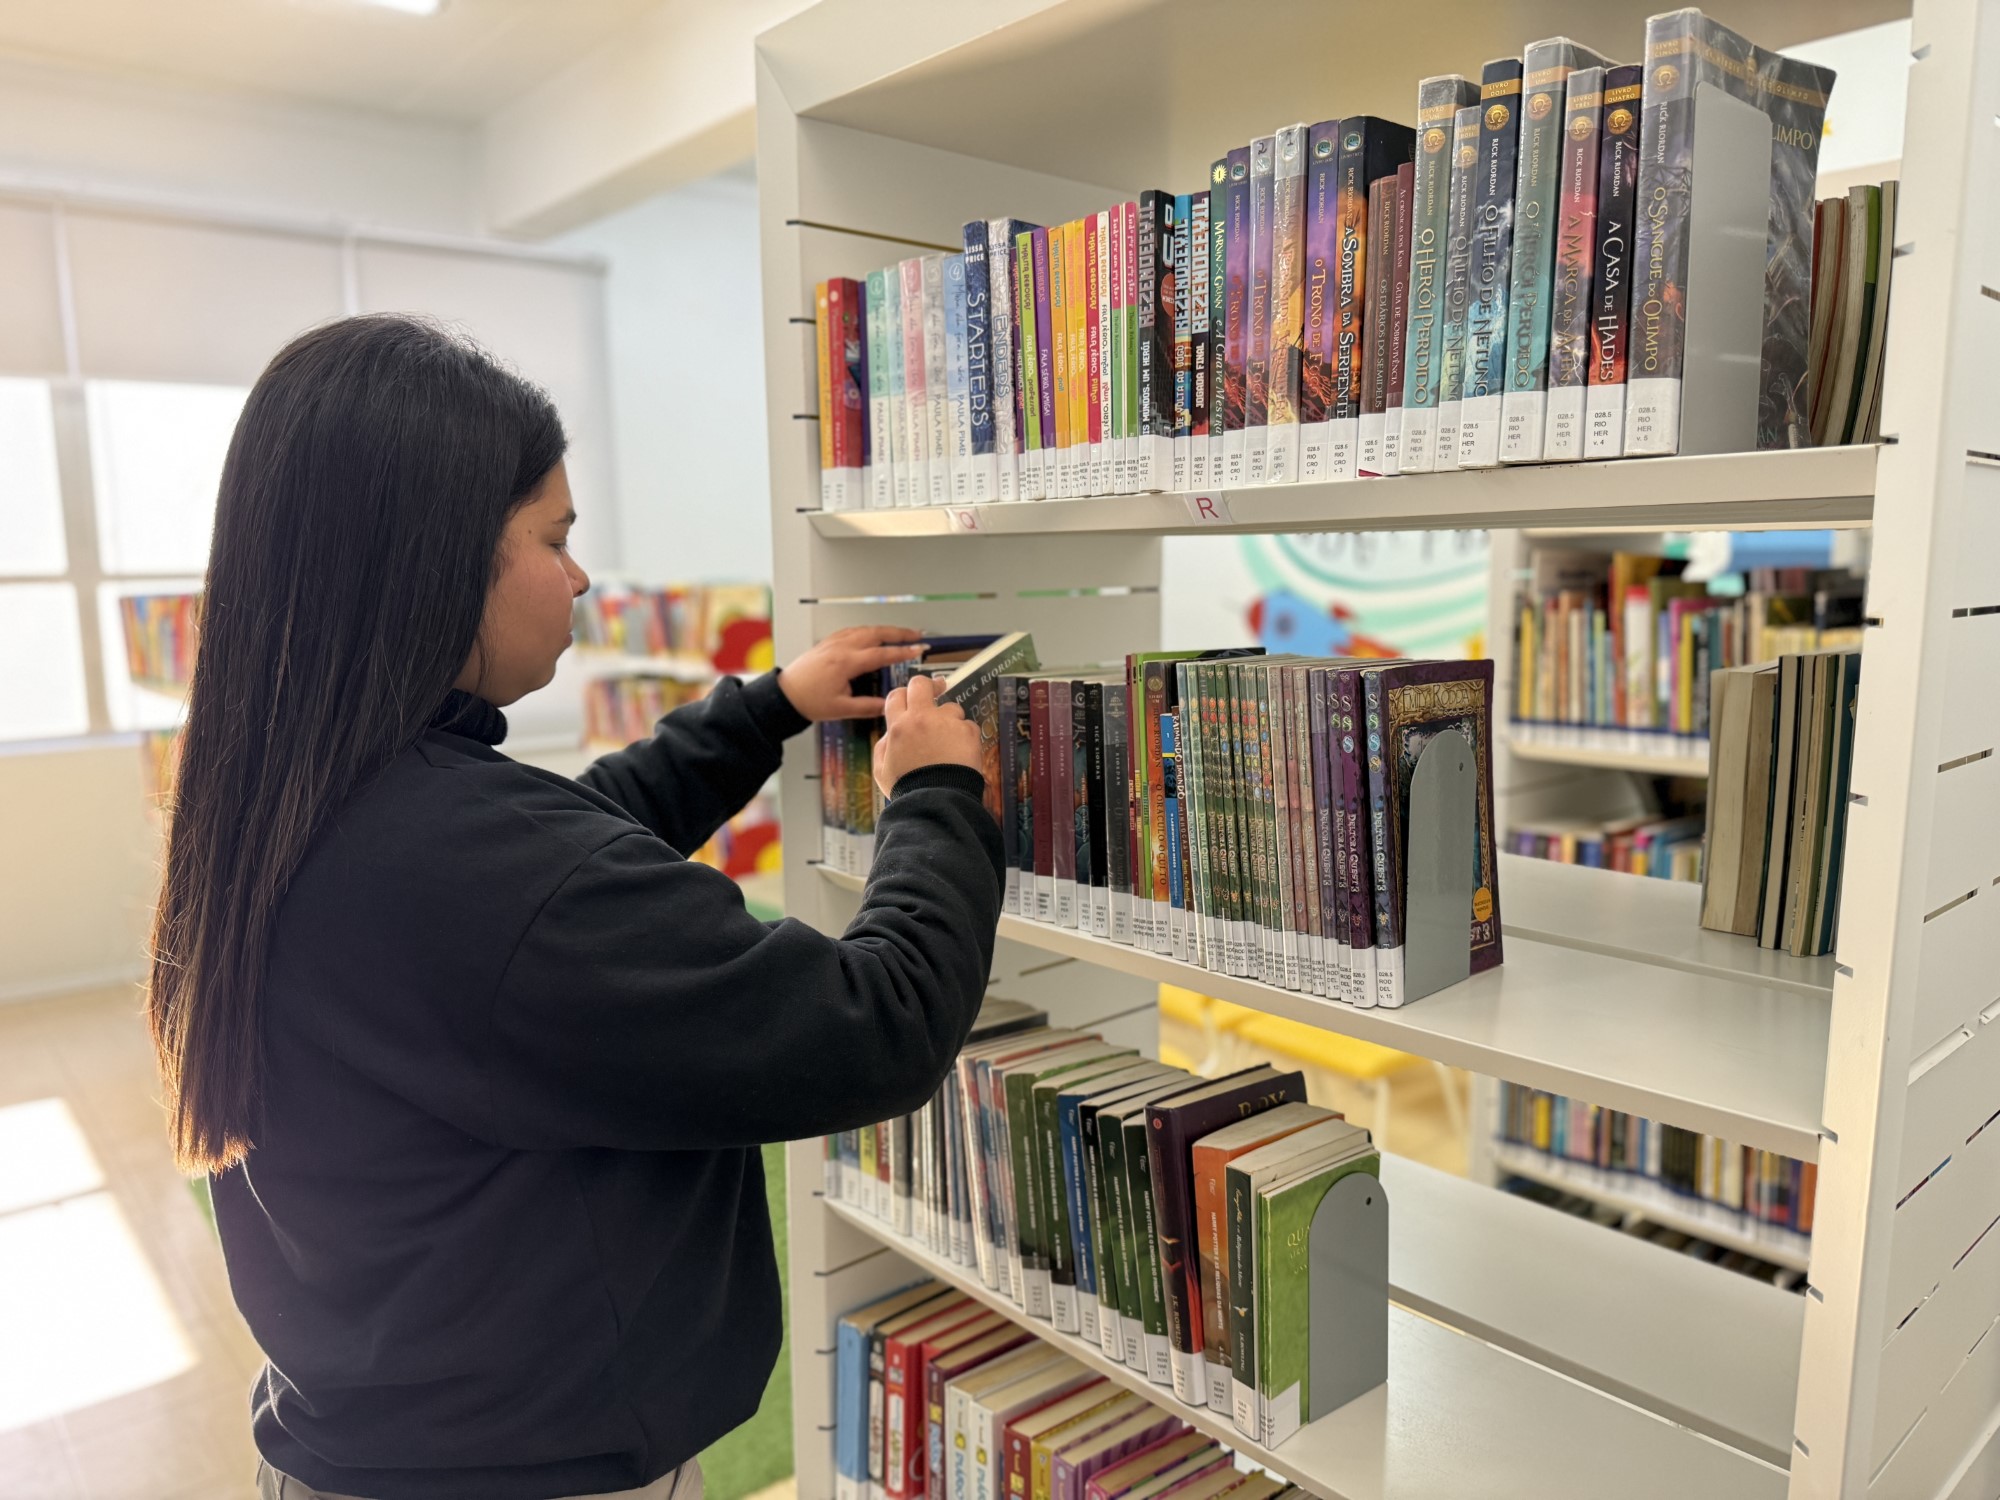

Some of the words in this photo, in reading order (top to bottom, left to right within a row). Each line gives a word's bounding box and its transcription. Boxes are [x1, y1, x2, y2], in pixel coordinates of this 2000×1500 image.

[1489, 82, 1509, 90] LIVRO
[1490, 89, 1506, 97] DOIS
[1608, 92, 1636, 103] QUATRO
[1612, 87, 1632, 96] LIVRO
[1659, 101, 1668, 122] RICK
[1257, 142, 1268, 156] 2
[1532, 128, 1540, 152] RICK
[1657, 124, 1666, 164] RIORDAN
[1489, 160, 1498, 196] RIORDAN
[1530, 154, 1540, 188] RIORDAN
[1613, 165, 1622, 198] RIORDAN
[1427, 180, 1435, 216] RIORDAN
[1574, 170, 1582, 203] RIORDAN
[1654, 187, 1666, 201] O
[1485, 205, 1498, 222] O
[1526, 201, 1540, 218] O
[1568, 216, 1580, 226] A
[1345, 226, 1353, 235] A
[1421, 228, 1435, 245] O
[1609, 220, 1621, 234] A
[1648, 200, 1668, 280] SANGUE
[966, 244, 983, 253] LISSA
[1214, 222, 1225, 262] MARVIN
[1456, 236, 1467, 250] O
[1479, 225, 1498, 285] FILHO
[965, 254, 984, 263] PRICE
[1315, 259, 1323, 267] O
[1564, 234, 1584, 305] MARCA
[1602, 238, 1624, 291] CASA
[1341, 238, 1358, 307] SOMBRA
[1416, 248, 1436, 310] HERÓI
[1452, 253, 1468, 305] FILHO
[1311, 269, 1326, 328] TRONO
[1380, 279, 1387, 294] OS
[1395, 282, 1404, 304] GUIA
[1648, 283, 1656, 297] DO
[1394, 307, 1401, 318] DE
[1479, 287, 1494, 316] DE
[1604, 295, 1614, 312] DE
[1342, 312, 1351, 327] DA
[1378, 295, 1388, 338] DIÁRIOS
[1452, 308, 1463, 332] DE
[1564, 310, 1572, 326] DE
[1216, 330, 1225, 338] A
[1312, 333, 1320, 348] DE
[1643, 299, 1662, 371] OLIMPO
[967, 292, 989, 426] STARTERS
[993, 314, 1009, 398] ENDERS
[1141, 341, 1150, 366] HERÓI
[1196, 342, 1204, 370] FINAL
[1378, 339, 1385, 356] DO
[1413, 313, 1434, 403] PERDIDO
[1473, 319, 1493, 397] NETUNO
[1598, 315, 1618, 381] HADES
[1142, 369, 1150, 382] UM
[1336, 332, 1354, 419] SERPENTE
[1375, 358, 1384, 408] SEMIDEUS
[1196, 372, 1204, 408] JOGADA
[960, 511, 977, 530] Q
[1196, 497, 1219, 519] R
[955, 684, 979, 704] RICK
[980, 649, 1026, 686] RIORDAN
[1433, 684, 1470, 707] RODDA
[1172, 716, 1183, 762] RAIMUNDO
[1176, 765, 1186, 799] IMUNDO
[1347, 814, 1356, 852] DELTORA
[1374, 811, 1383, 851] DELTORA
[1350, 854, 1359, 885] QUEST
[1376, 852, 1385, 884] QUEST
